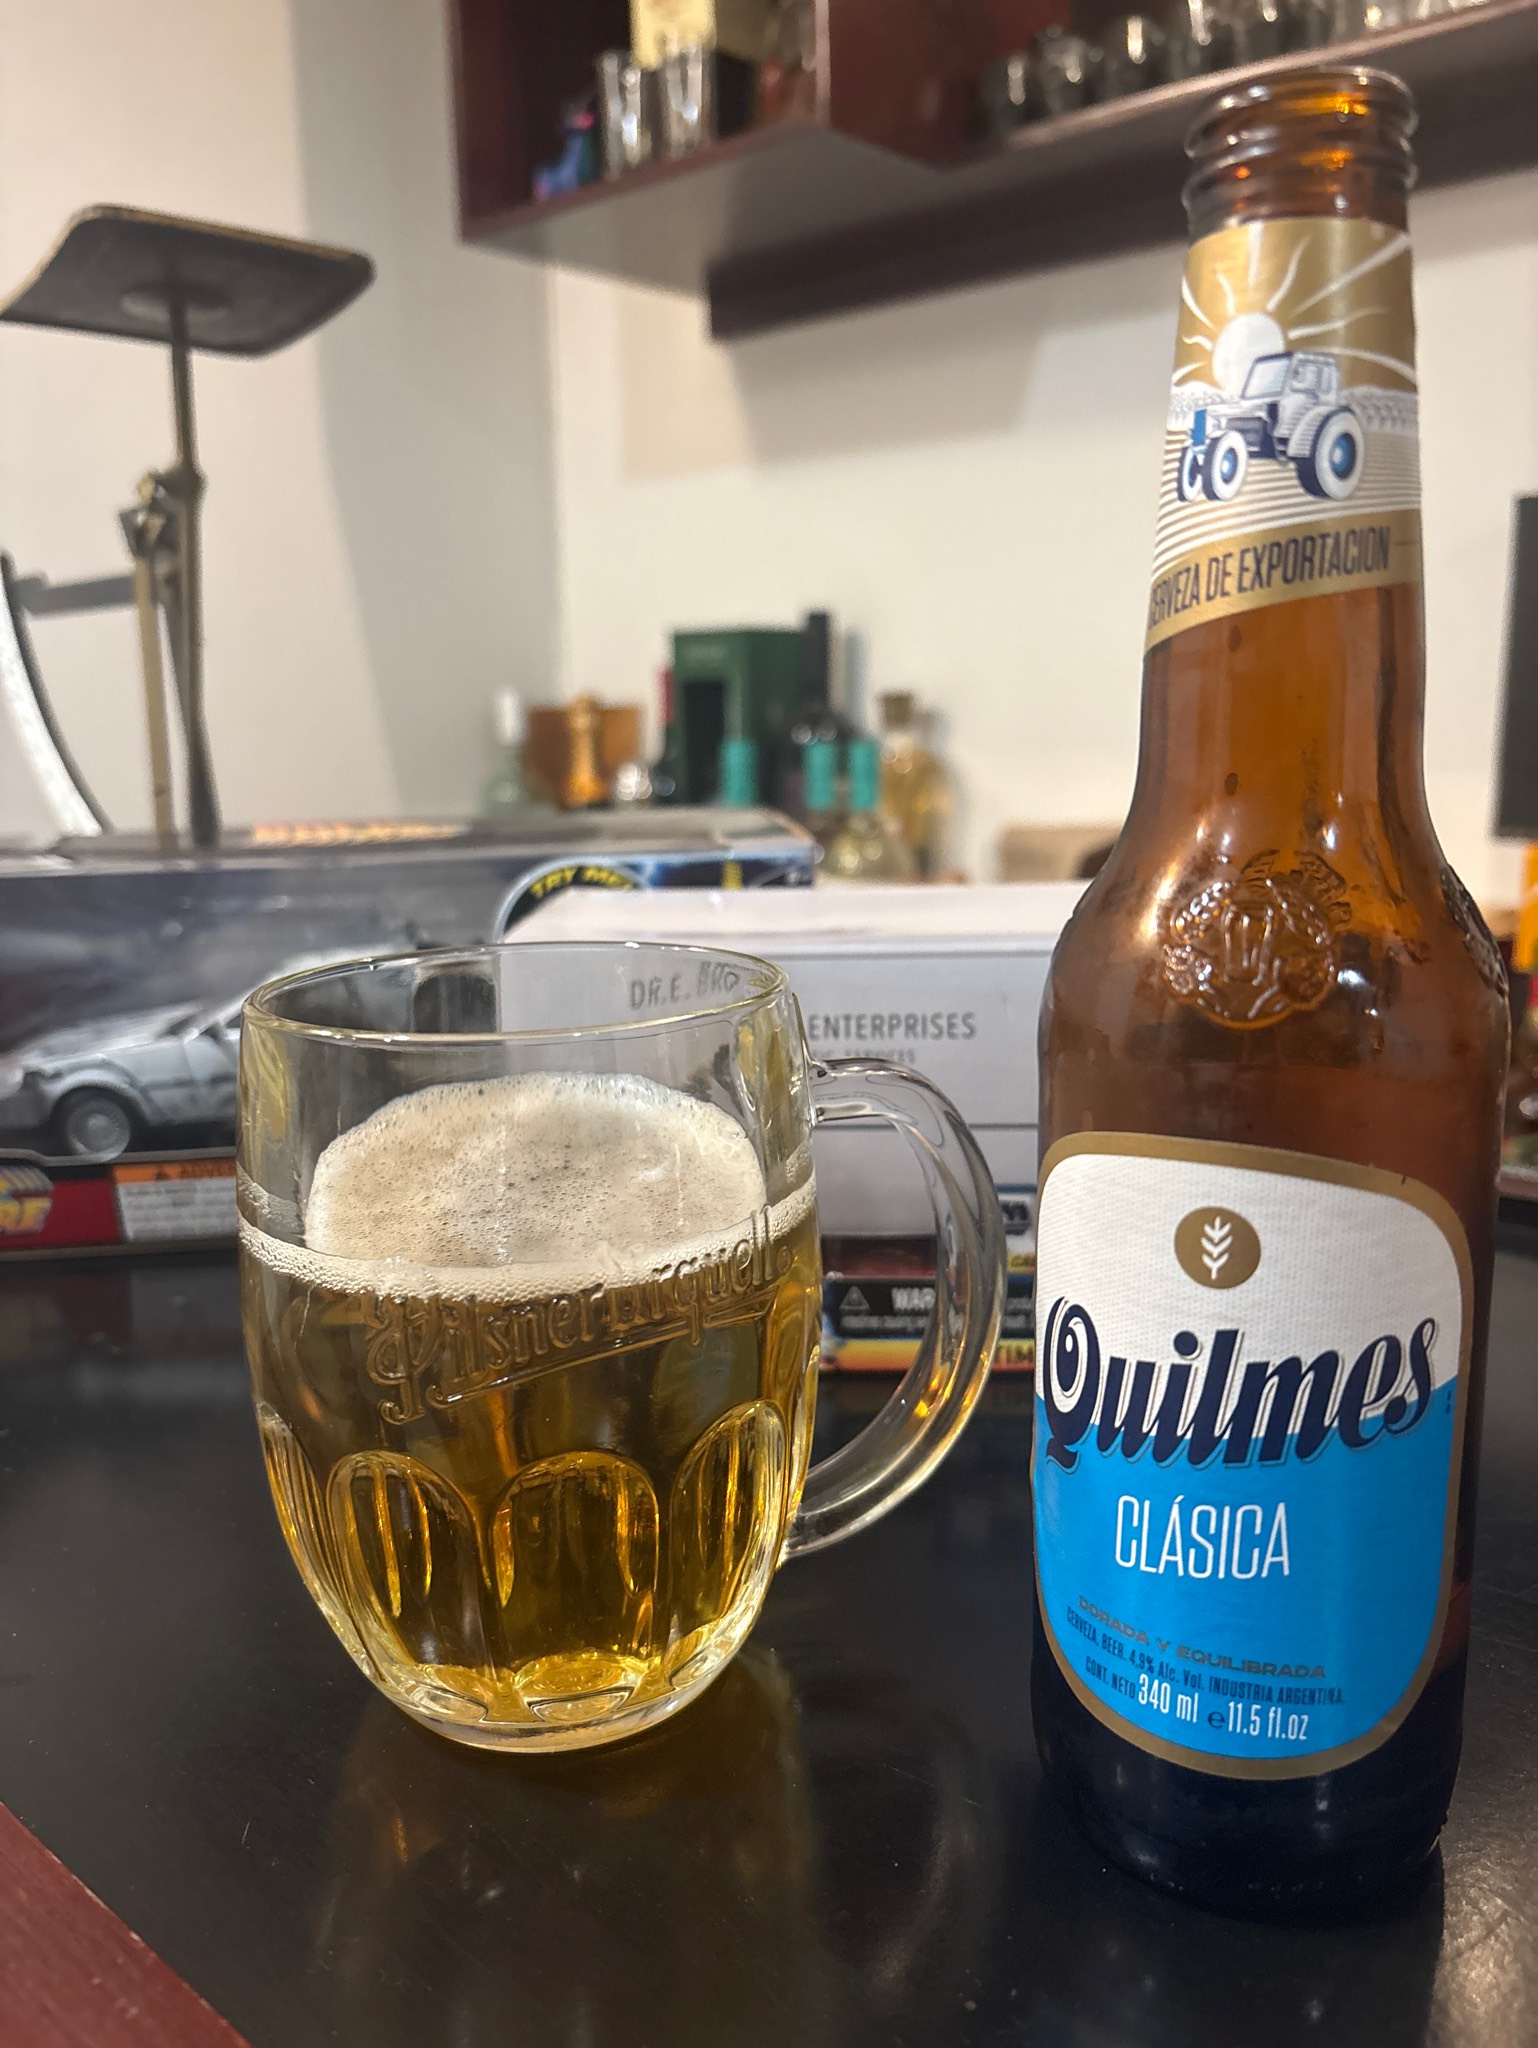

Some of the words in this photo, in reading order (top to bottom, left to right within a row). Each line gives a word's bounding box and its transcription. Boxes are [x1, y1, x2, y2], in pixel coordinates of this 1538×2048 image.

[1149, 563, 1200, 627] ERVEZA
[1205, 552, 1234, 602] DE
[1236, 526, 1392, 594] EXPORTACION
[696, 961, 741, 997] BRO
[807, 1011, 977, 1041] ENTERPRISES
[1043, 1296, 1439, 1474] Quilmes
[1114, 1495, 1291, 1579] CLÁSICA
[1078, 1595, 1150, 1646] DORADA
[1156, 1637, 1171, 1653] Y
[1176, 1645, 1327, 1679] EQUILIBRADA
[1101, 1632, 1127, 1662] BEER.
[1157, 1660, 1180, 1684] Alc.
[1182, 1668, 1206, 1692] Vol.
[1208, 1675, 1274, 1704] INDUSTRIA
[1085, 1655, 1110, 1685] CONT.
[1111, 1673, 1137, 1700] NETO
[1138, 1673, 1171, 1715] 340
[1176, 1692, 1200, 1724] ml
[1227, 1700, 1263, 1737] 11.5
